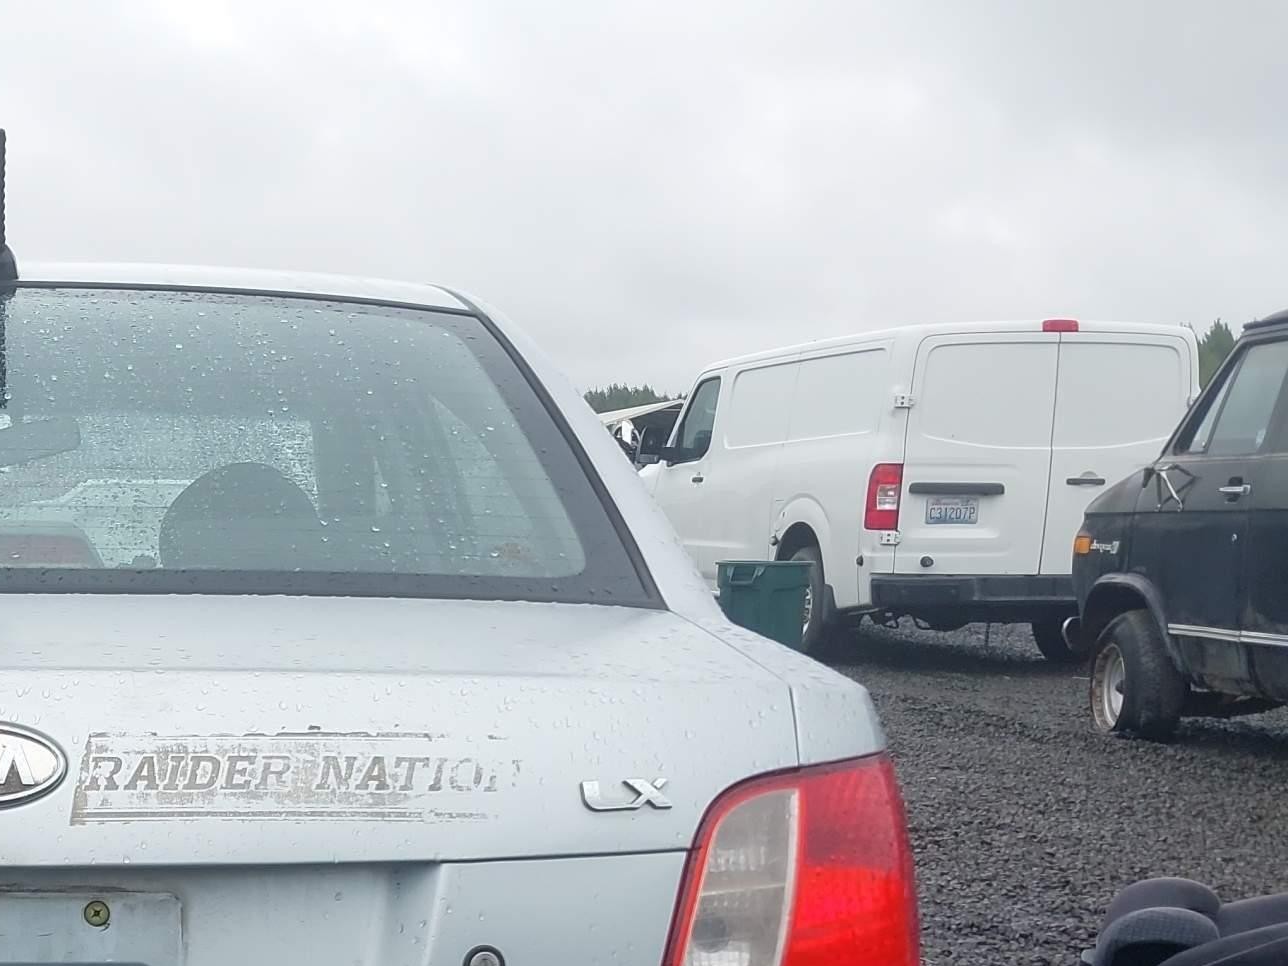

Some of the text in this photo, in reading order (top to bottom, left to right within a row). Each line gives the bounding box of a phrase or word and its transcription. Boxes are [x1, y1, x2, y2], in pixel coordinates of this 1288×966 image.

[928, 506, 976, 520] C31207P
[84, 755, 290, 792] RAIDER
[579, 777, 673, 812] LX
